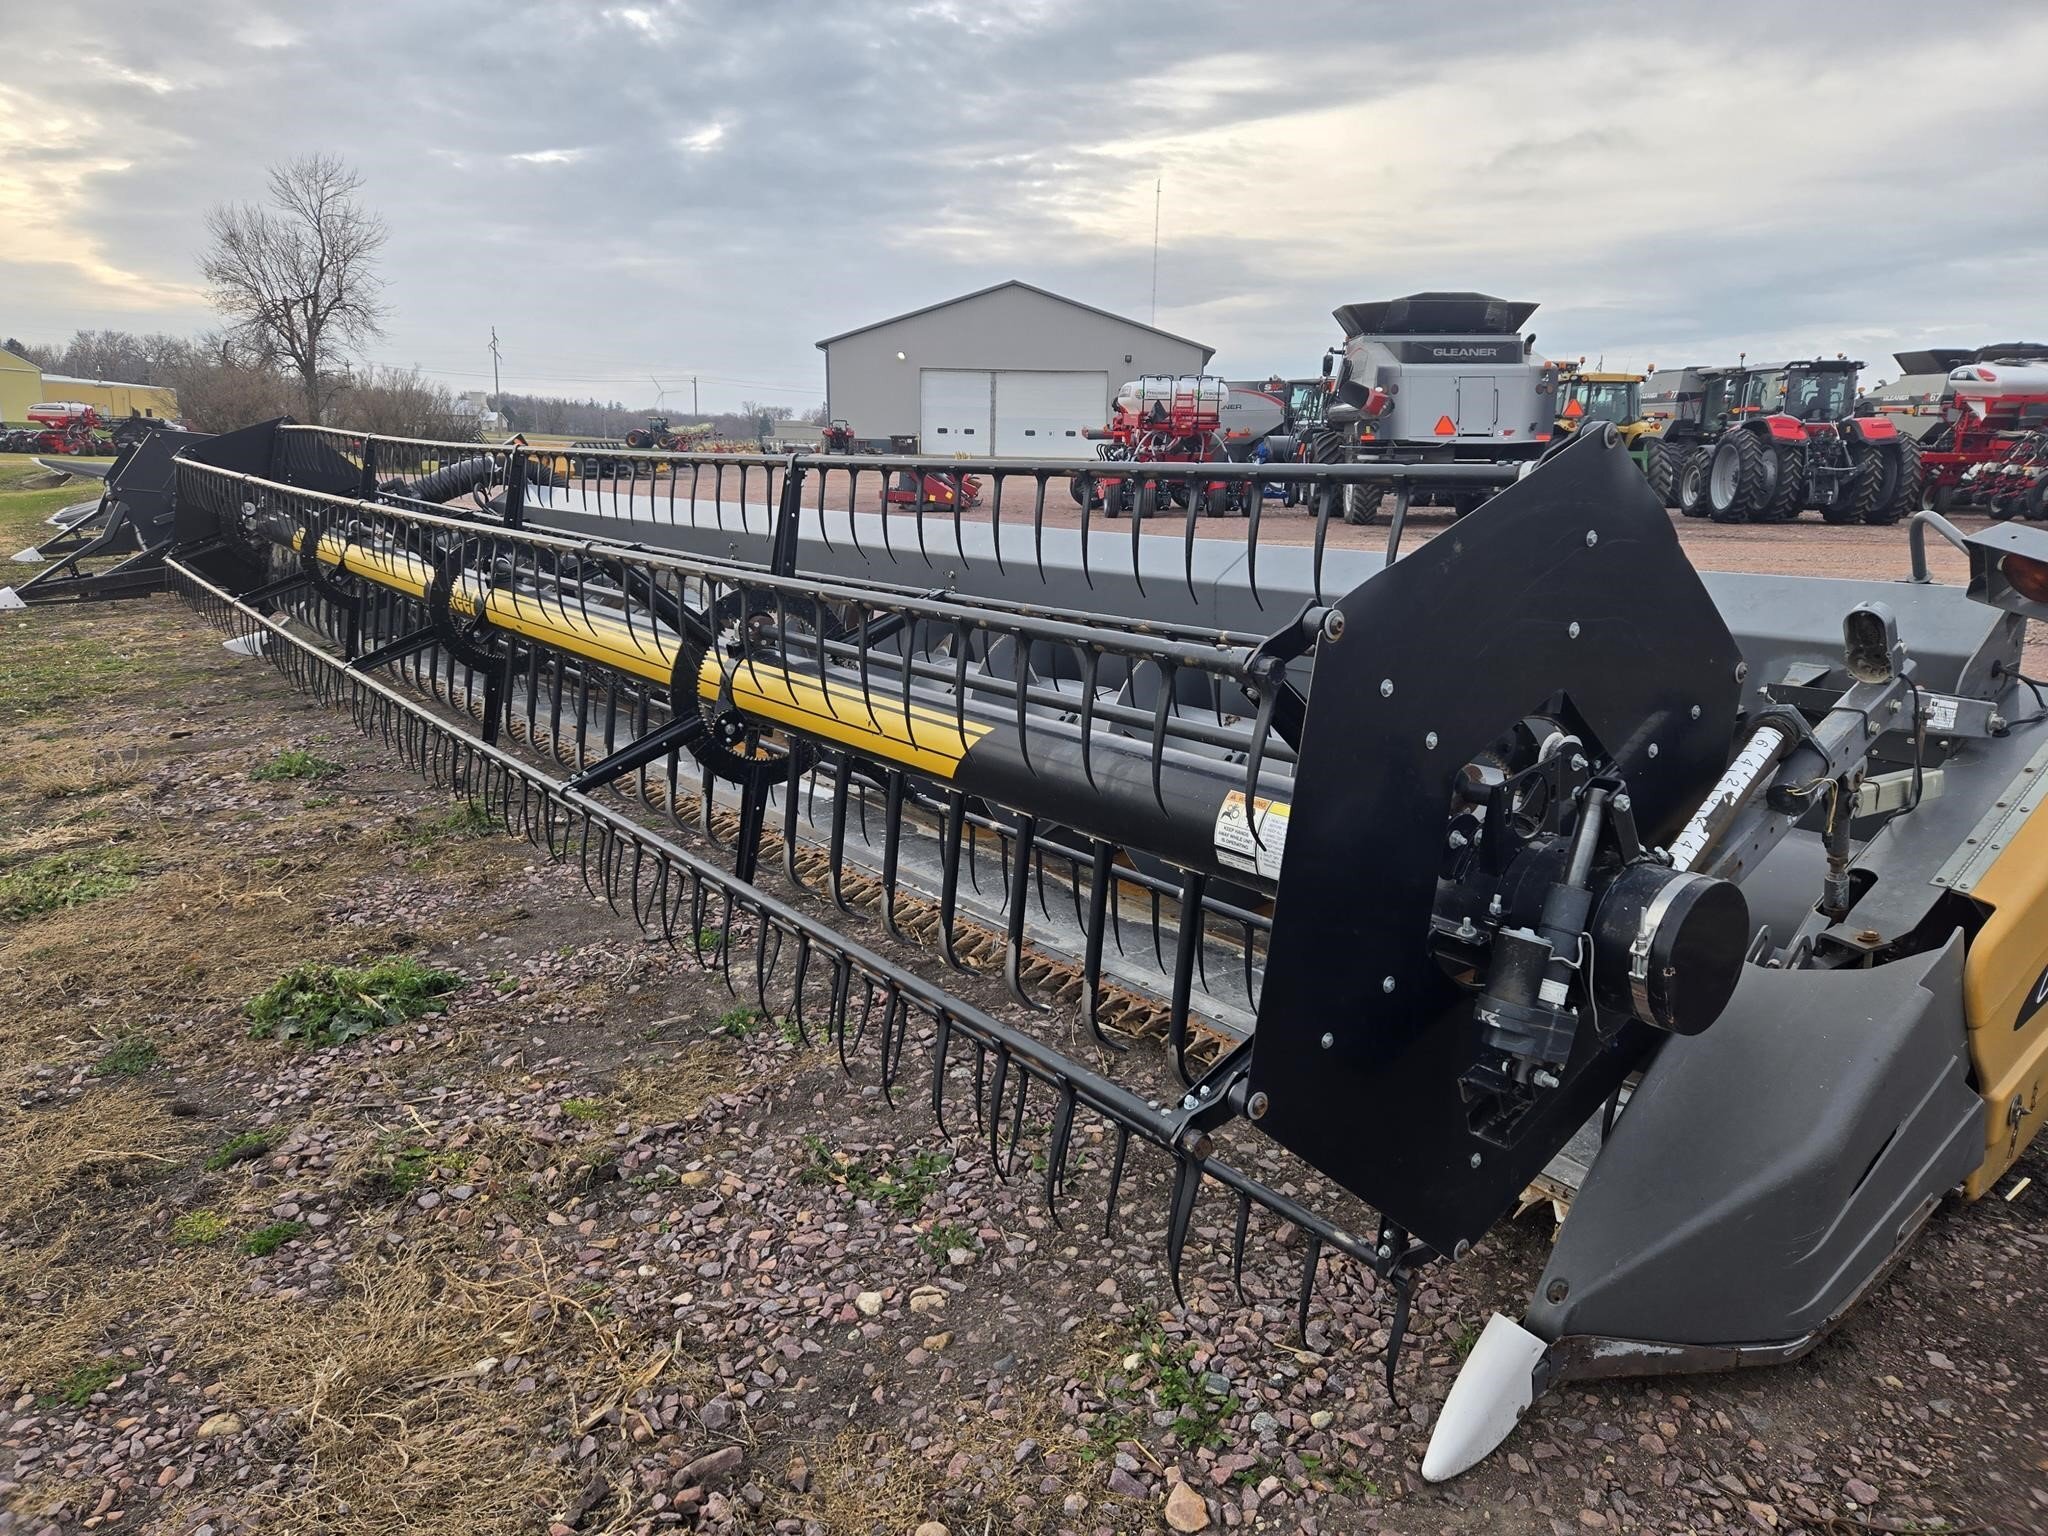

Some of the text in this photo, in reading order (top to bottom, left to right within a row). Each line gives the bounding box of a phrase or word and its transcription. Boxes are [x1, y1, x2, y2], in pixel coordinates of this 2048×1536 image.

[1433, 348, 1497, 357] GLEANER
[1741, 758, 1754, 768] 4
[1726, 777, 1740, 787] 2
[1680, 840, 1693, 849] 4
